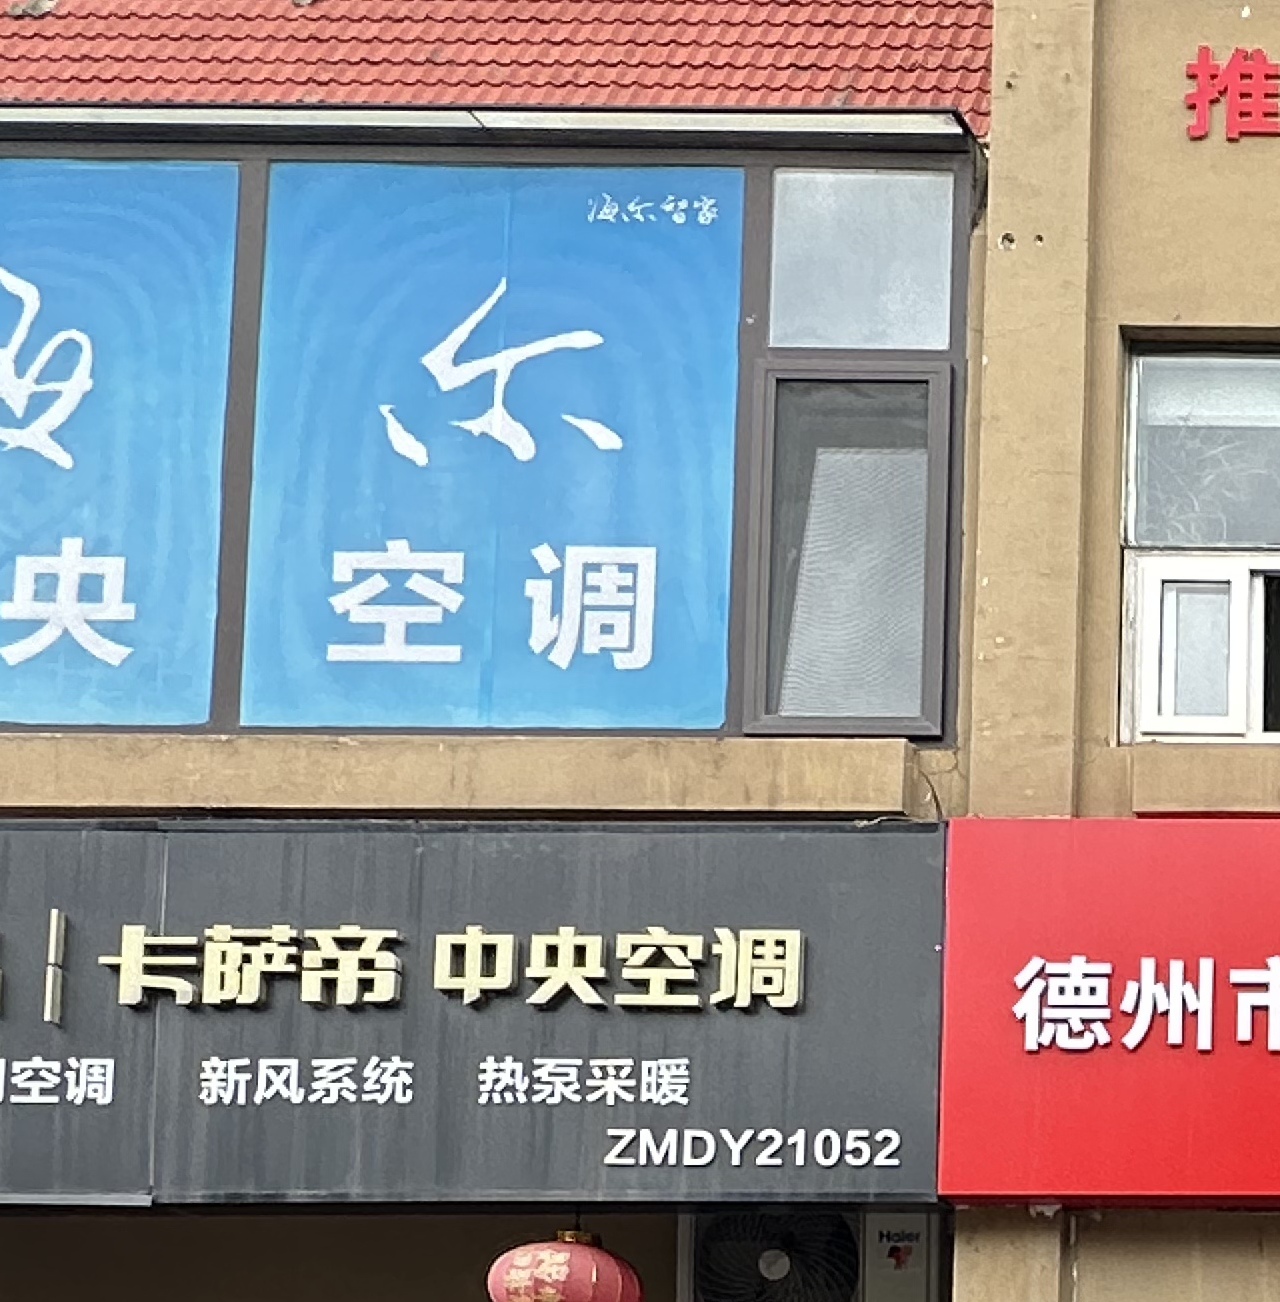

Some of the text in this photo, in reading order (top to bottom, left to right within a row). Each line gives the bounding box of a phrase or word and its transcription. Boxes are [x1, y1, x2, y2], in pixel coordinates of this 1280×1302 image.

[326, 538, 657, 671] 空调
[98, 924, 806, 1010] 卡萨帝 中央空调
[0, 1056, 690, 1107] 空调 新风系统 热泵采暖
[604, 1128, 901, 1168] ZMDY21052
[878, 1230, 922, 1245] Haier
